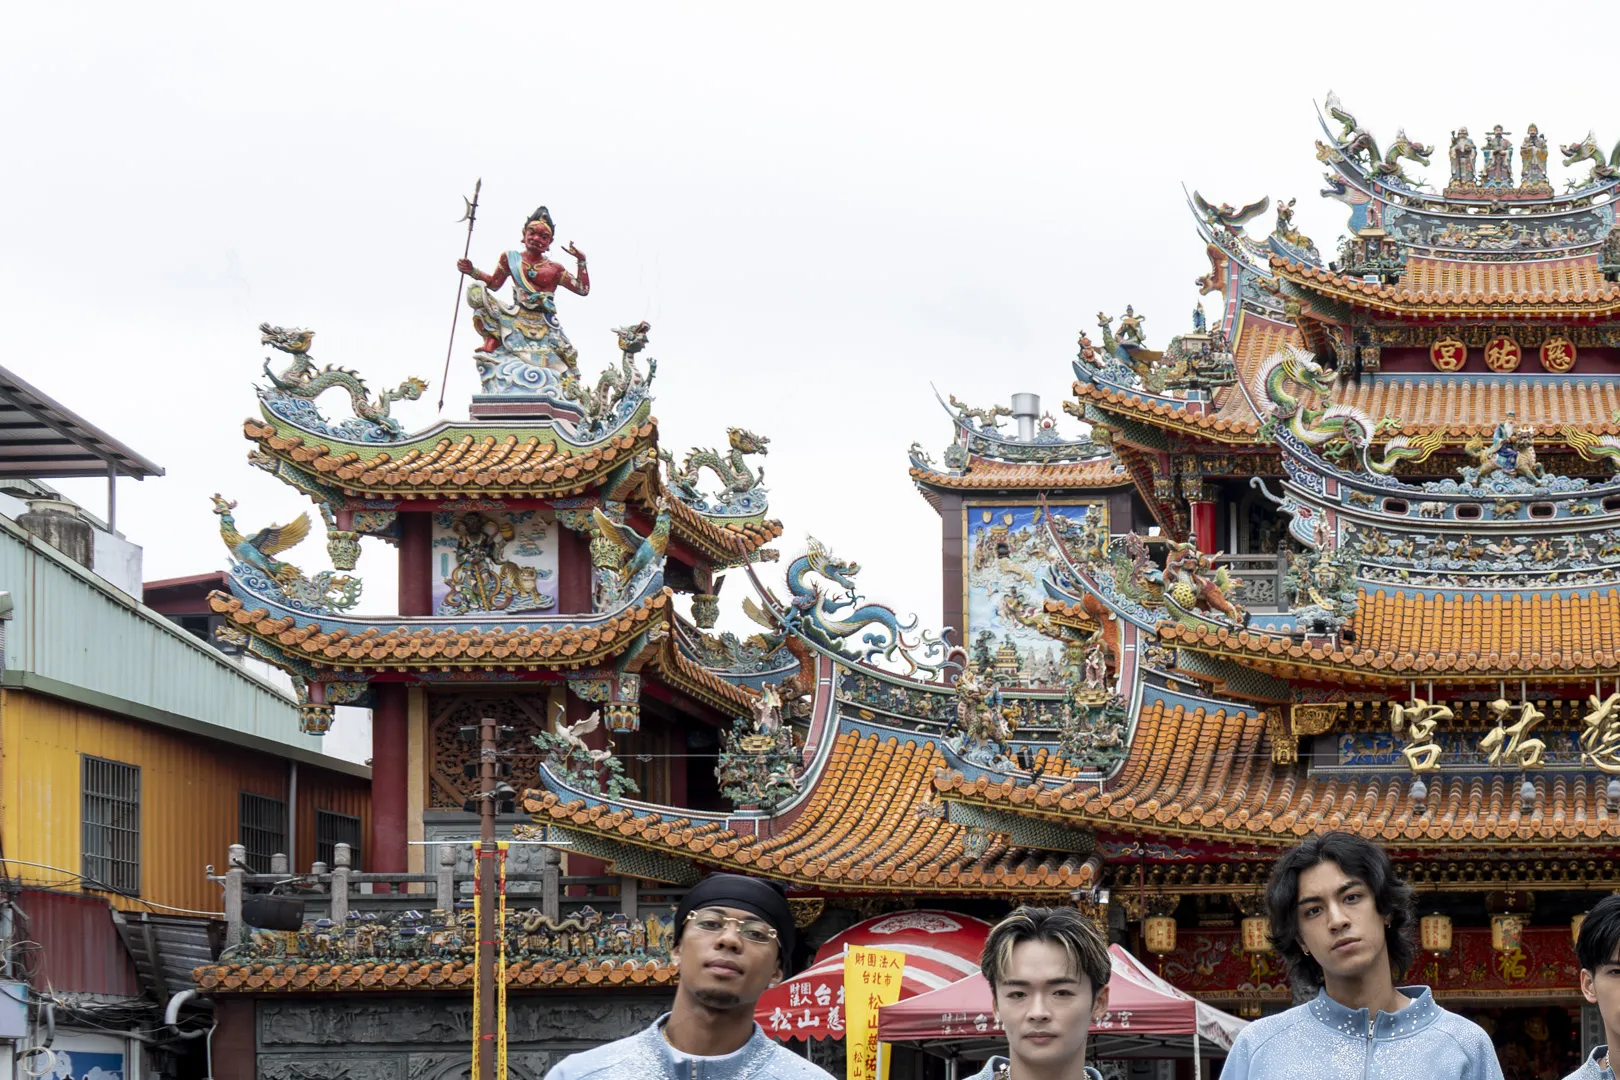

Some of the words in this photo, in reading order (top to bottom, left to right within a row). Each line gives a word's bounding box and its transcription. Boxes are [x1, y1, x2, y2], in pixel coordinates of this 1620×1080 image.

[855, 953, 900, 969] 財團法人
[862, 971, 892, 986] 台北市
[769, 1007, 845, 1032] 松山慈
